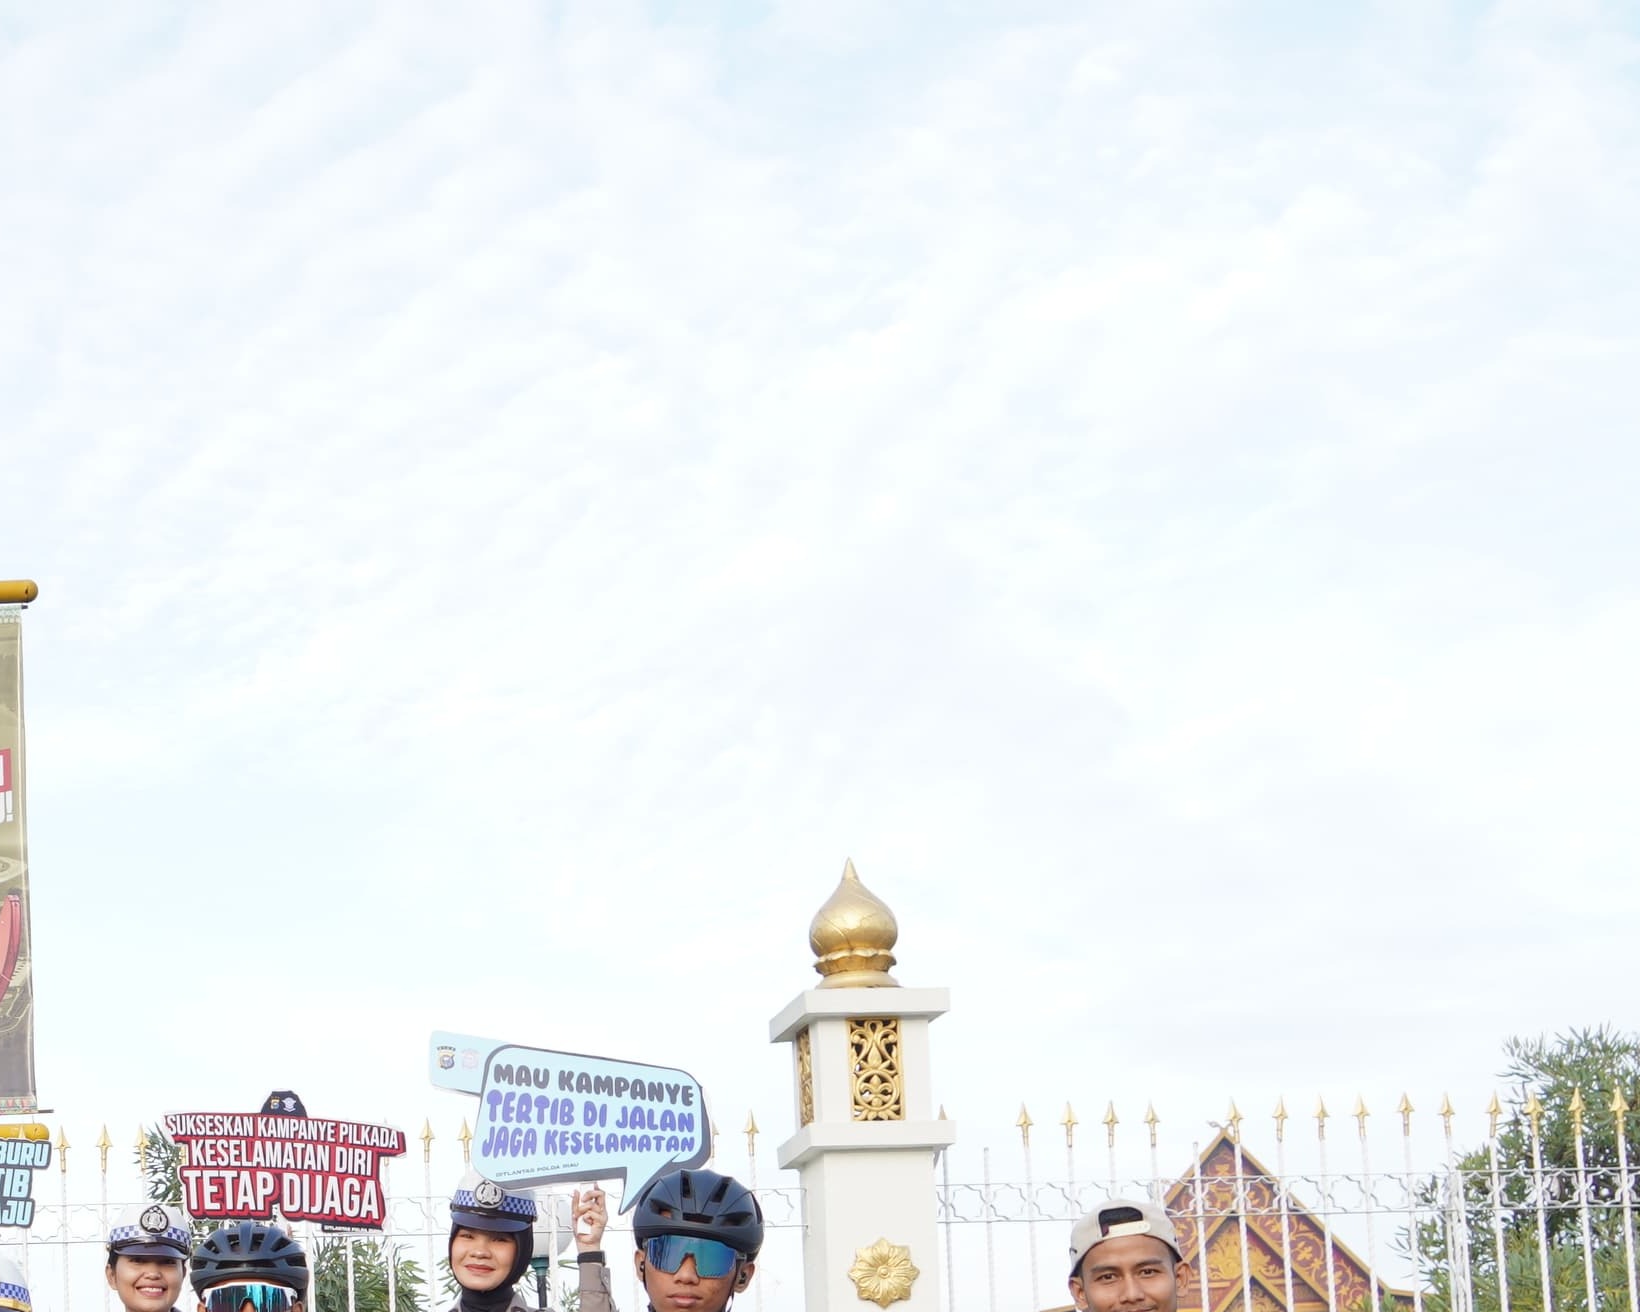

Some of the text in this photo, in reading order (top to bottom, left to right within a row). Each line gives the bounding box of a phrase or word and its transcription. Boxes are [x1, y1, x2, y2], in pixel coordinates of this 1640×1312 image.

[493, 1063, 694, 1107] MAU KAMPANYE
[166, 1114, 399, 1149] SUKSESKAN KAMPANYE PILKADA
[486, 1089, 695, 1133] TERTIB DI JALAN
[191, 1139, 372, 1177] KESELAMATAN DIRI
[482, 1126, 695, 1159] JAGA KESELAMATAN
[183, 1169, 380, 1220] TETAP DIJAGA
